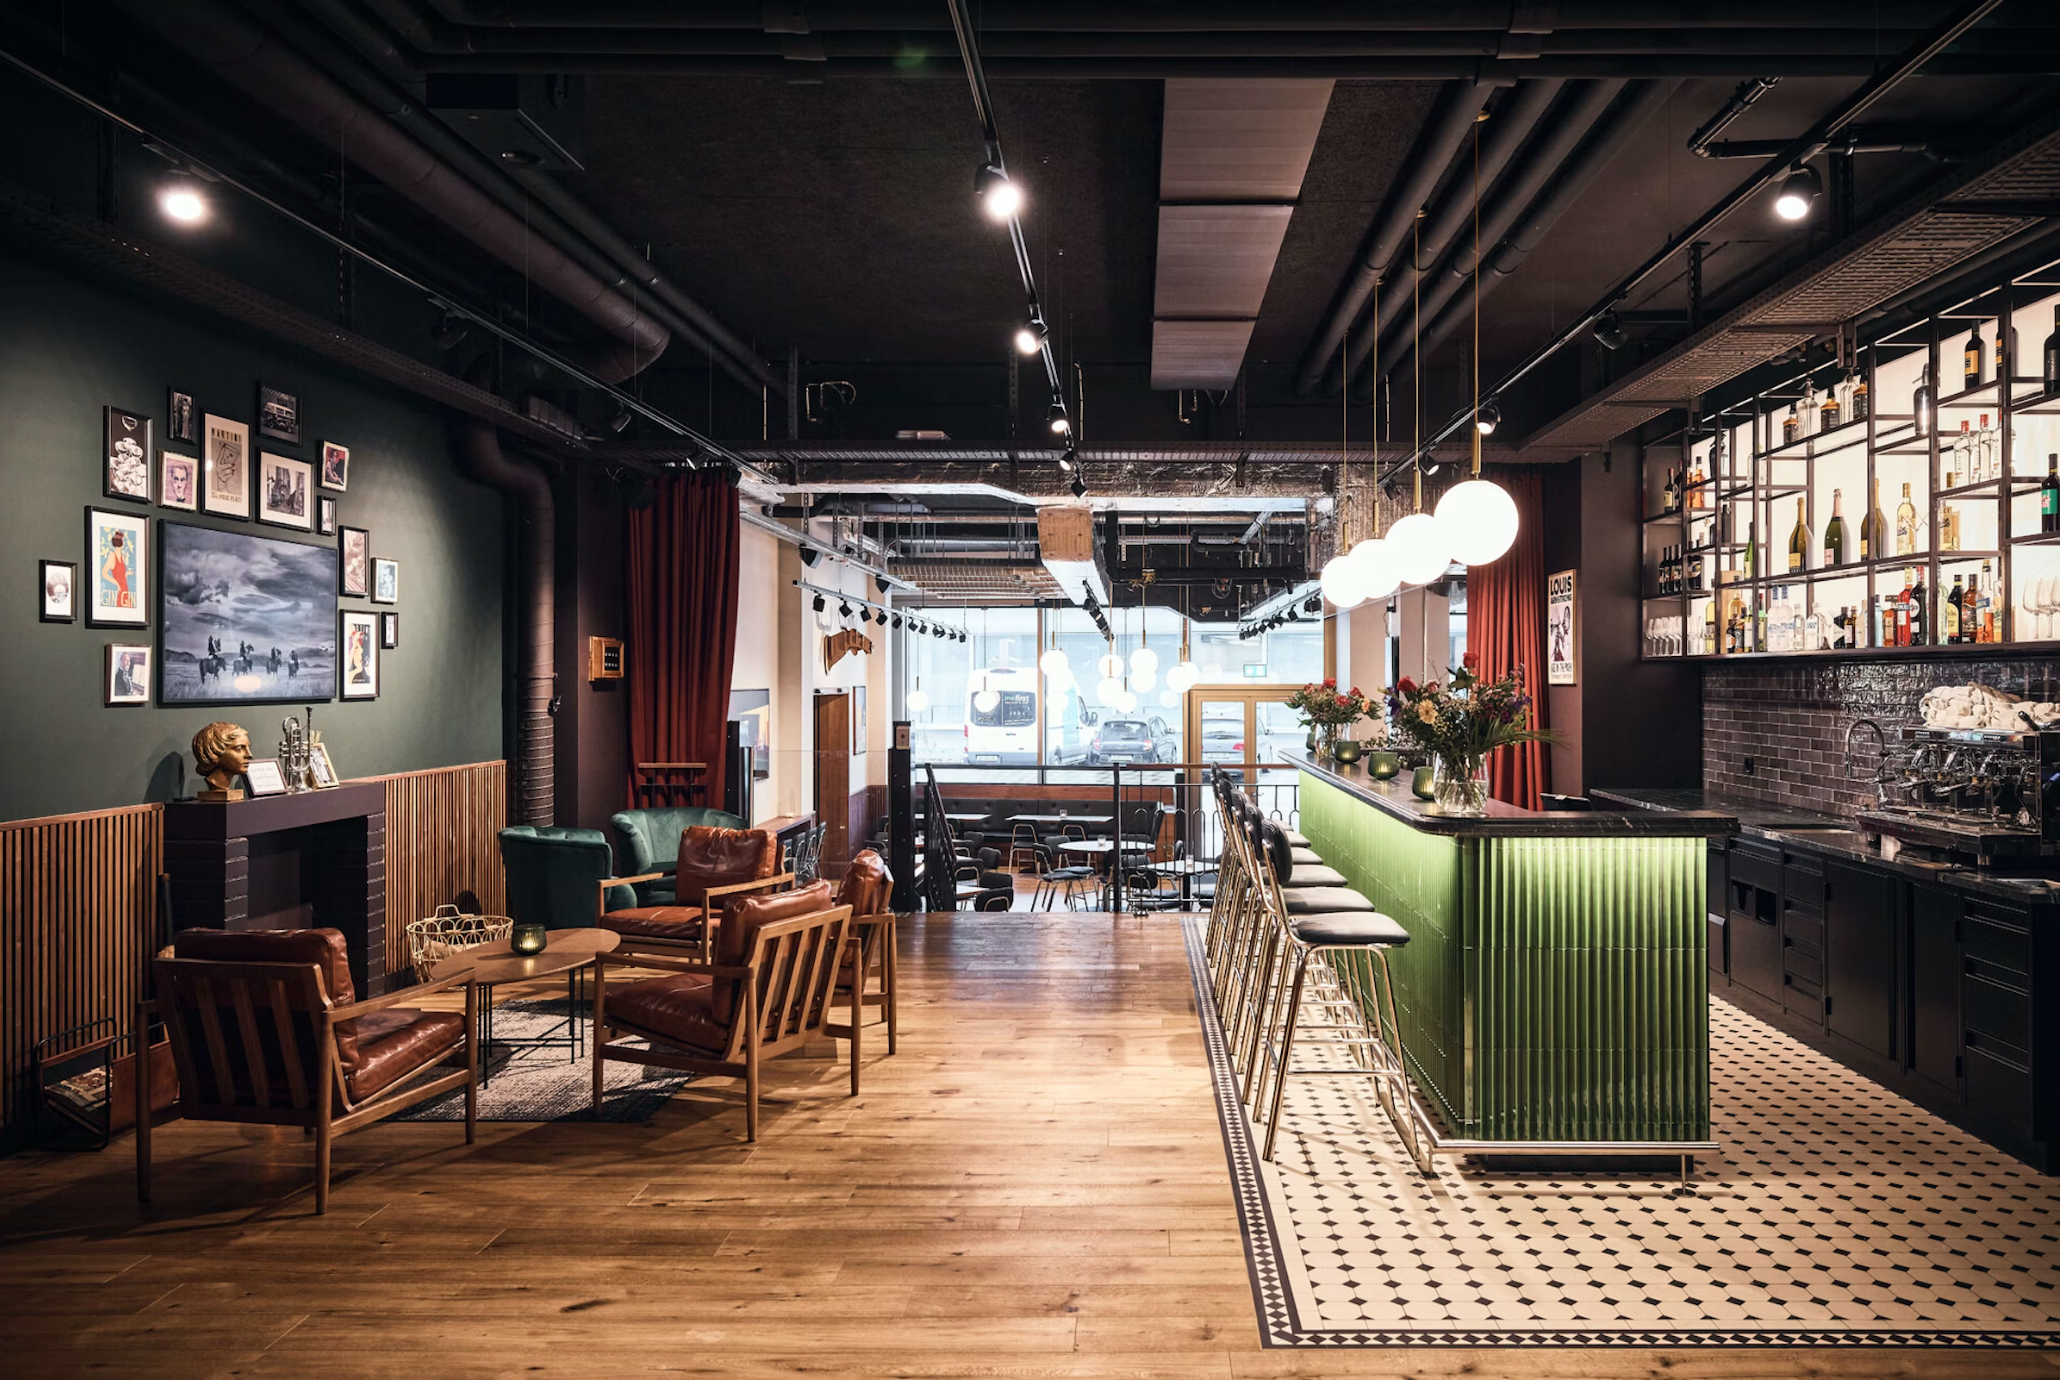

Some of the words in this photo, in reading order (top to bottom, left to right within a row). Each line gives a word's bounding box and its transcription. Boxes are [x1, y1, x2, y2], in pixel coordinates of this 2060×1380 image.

[211, 427, 242, 443] MARTINI
[1550, 575, 1572, 596] LOUIS
[101, 589, 117, 607] GIN
[121, 590, 137, 608] GIN
